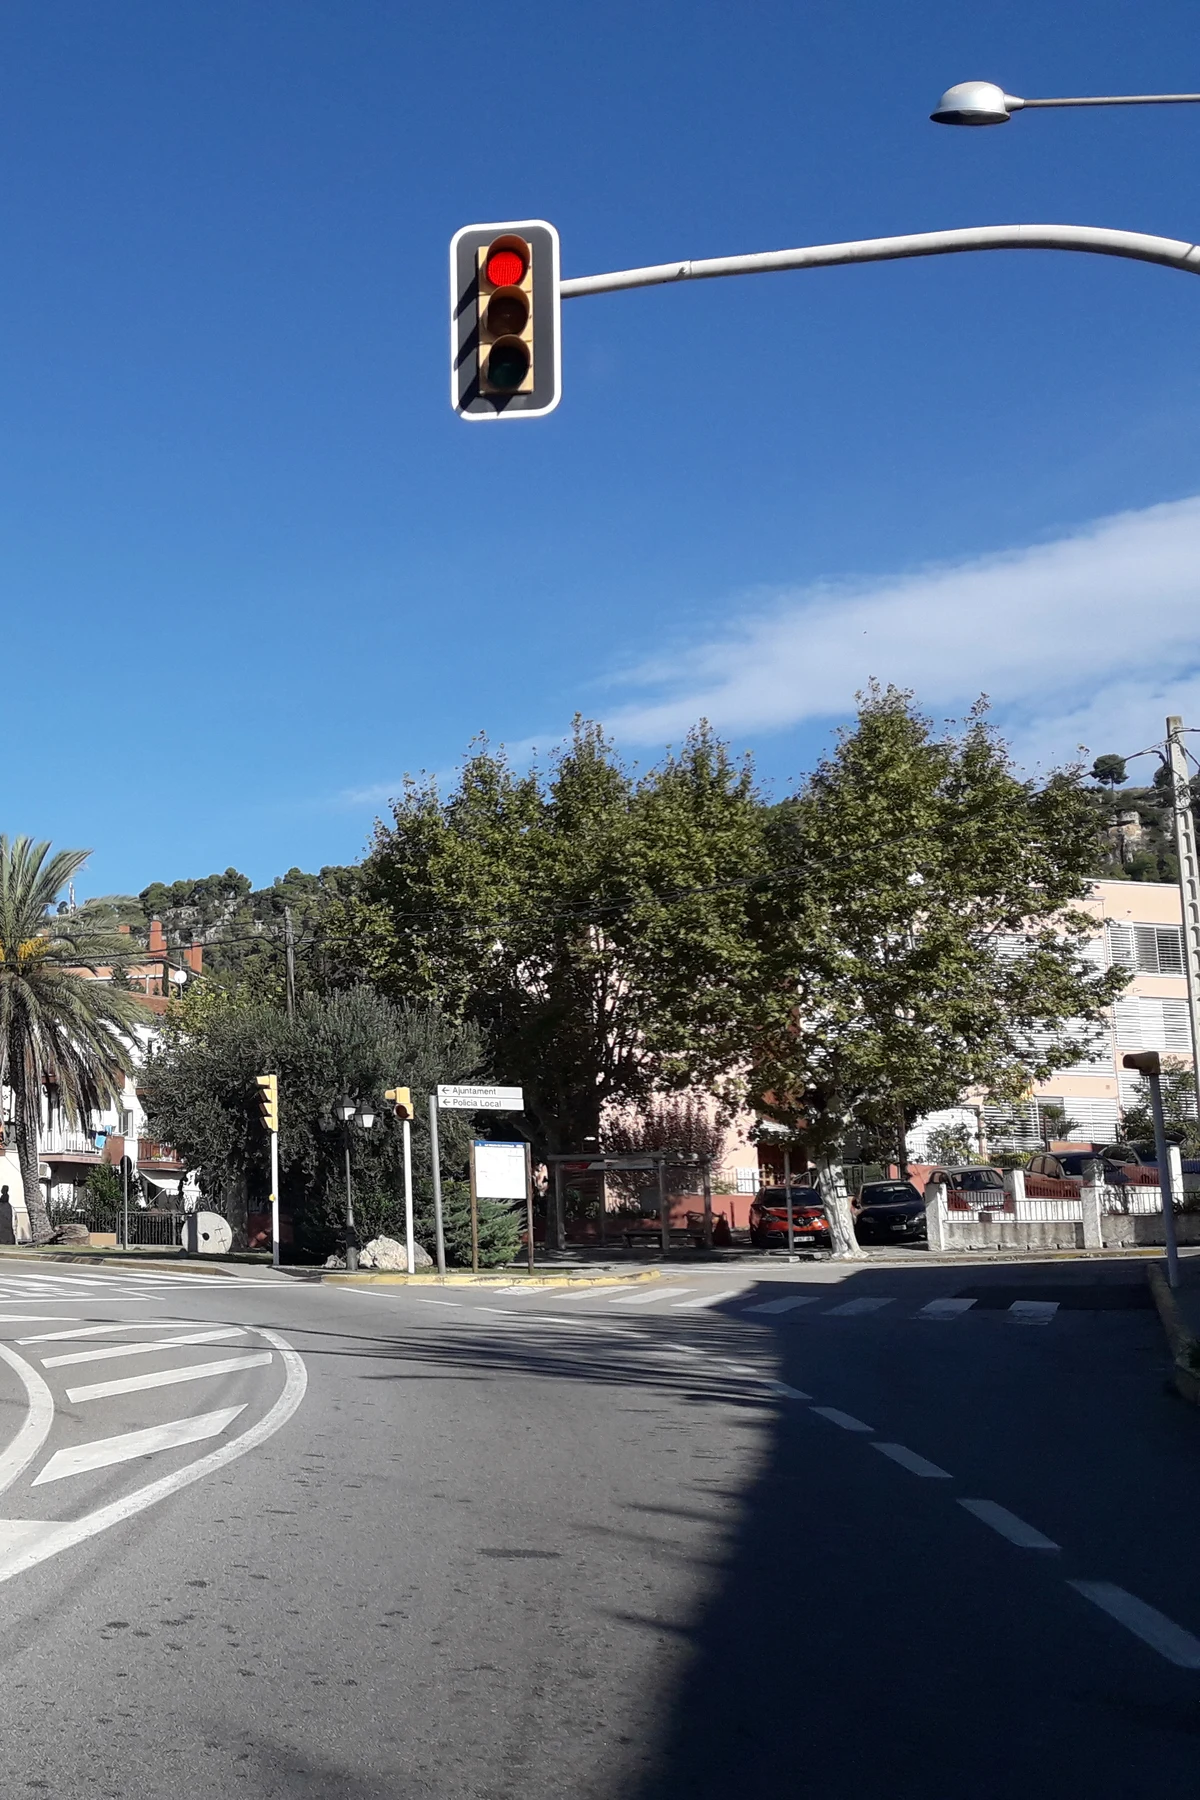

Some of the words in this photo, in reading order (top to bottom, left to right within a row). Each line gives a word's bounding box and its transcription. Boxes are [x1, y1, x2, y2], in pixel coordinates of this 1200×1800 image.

[452, 1086, 497, 1096] Ajuntament
[452, 1098, 478, 1107] Policia
[480, 1100, 502, 1108] Local
